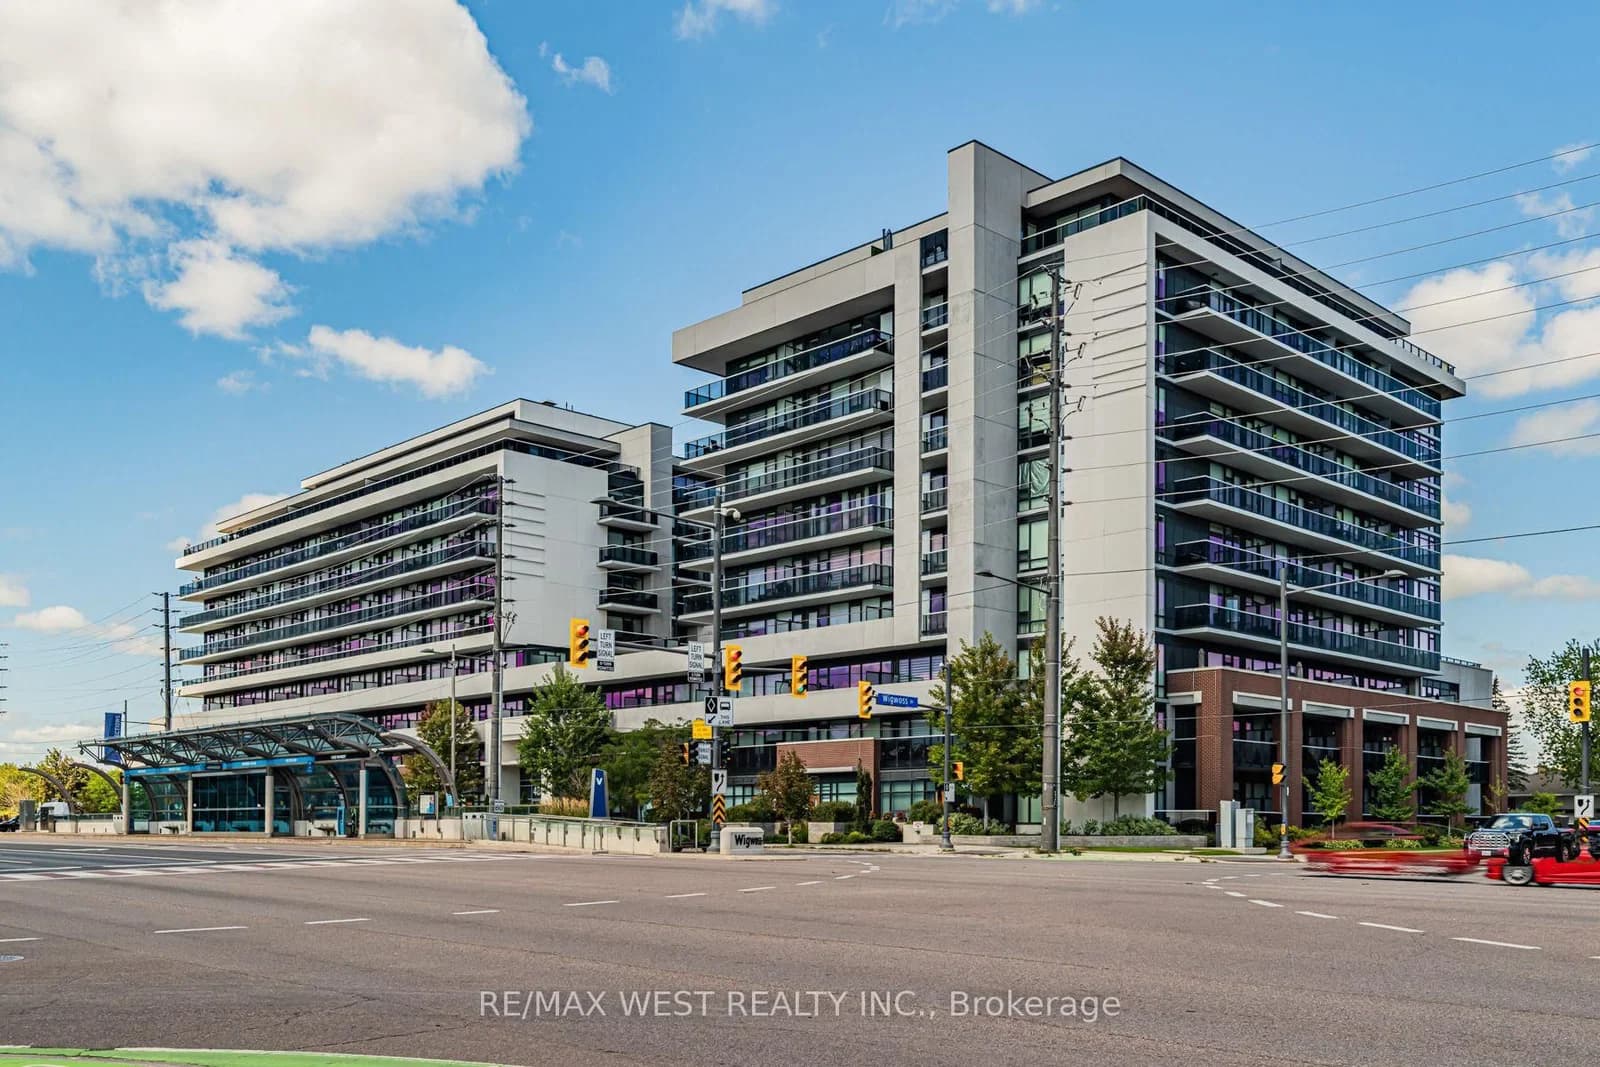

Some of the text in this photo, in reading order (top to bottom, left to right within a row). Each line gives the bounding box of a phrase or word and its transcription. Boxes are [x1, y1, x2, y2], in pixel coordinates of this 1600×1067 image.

[600, 632, 611, 640] LEFT
[691, 644, 702, 652] LEFT
[690, 652, 703, 660] TURN
